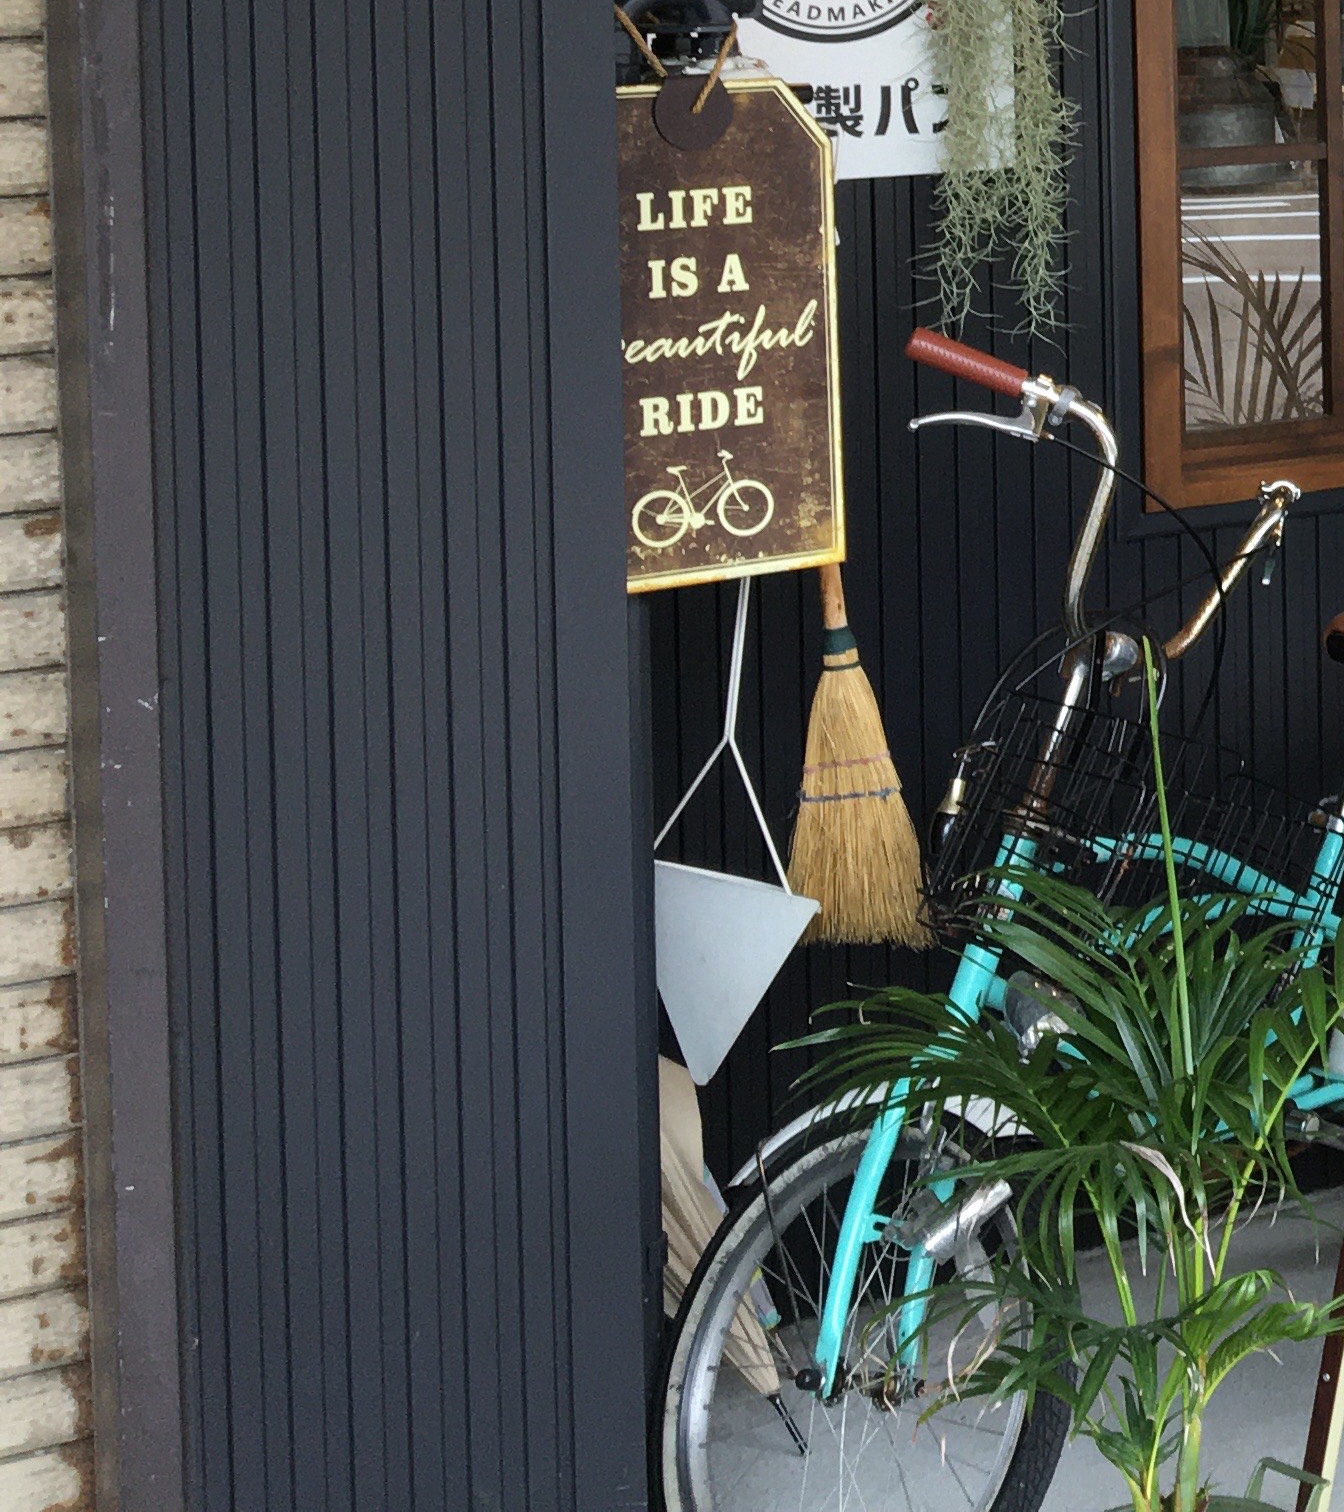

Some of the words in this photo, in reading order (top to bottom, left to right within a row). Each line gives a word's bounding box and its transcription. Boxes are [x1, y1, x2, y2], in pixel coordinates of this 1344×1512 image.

[636, 186, 753, 231] LIFE
[648, 257, 699, 299] IS
[717, 254, 750, 293] A
[621, 299, 818, 381] eautiful
[639, 386, 764, 437] RIDE
